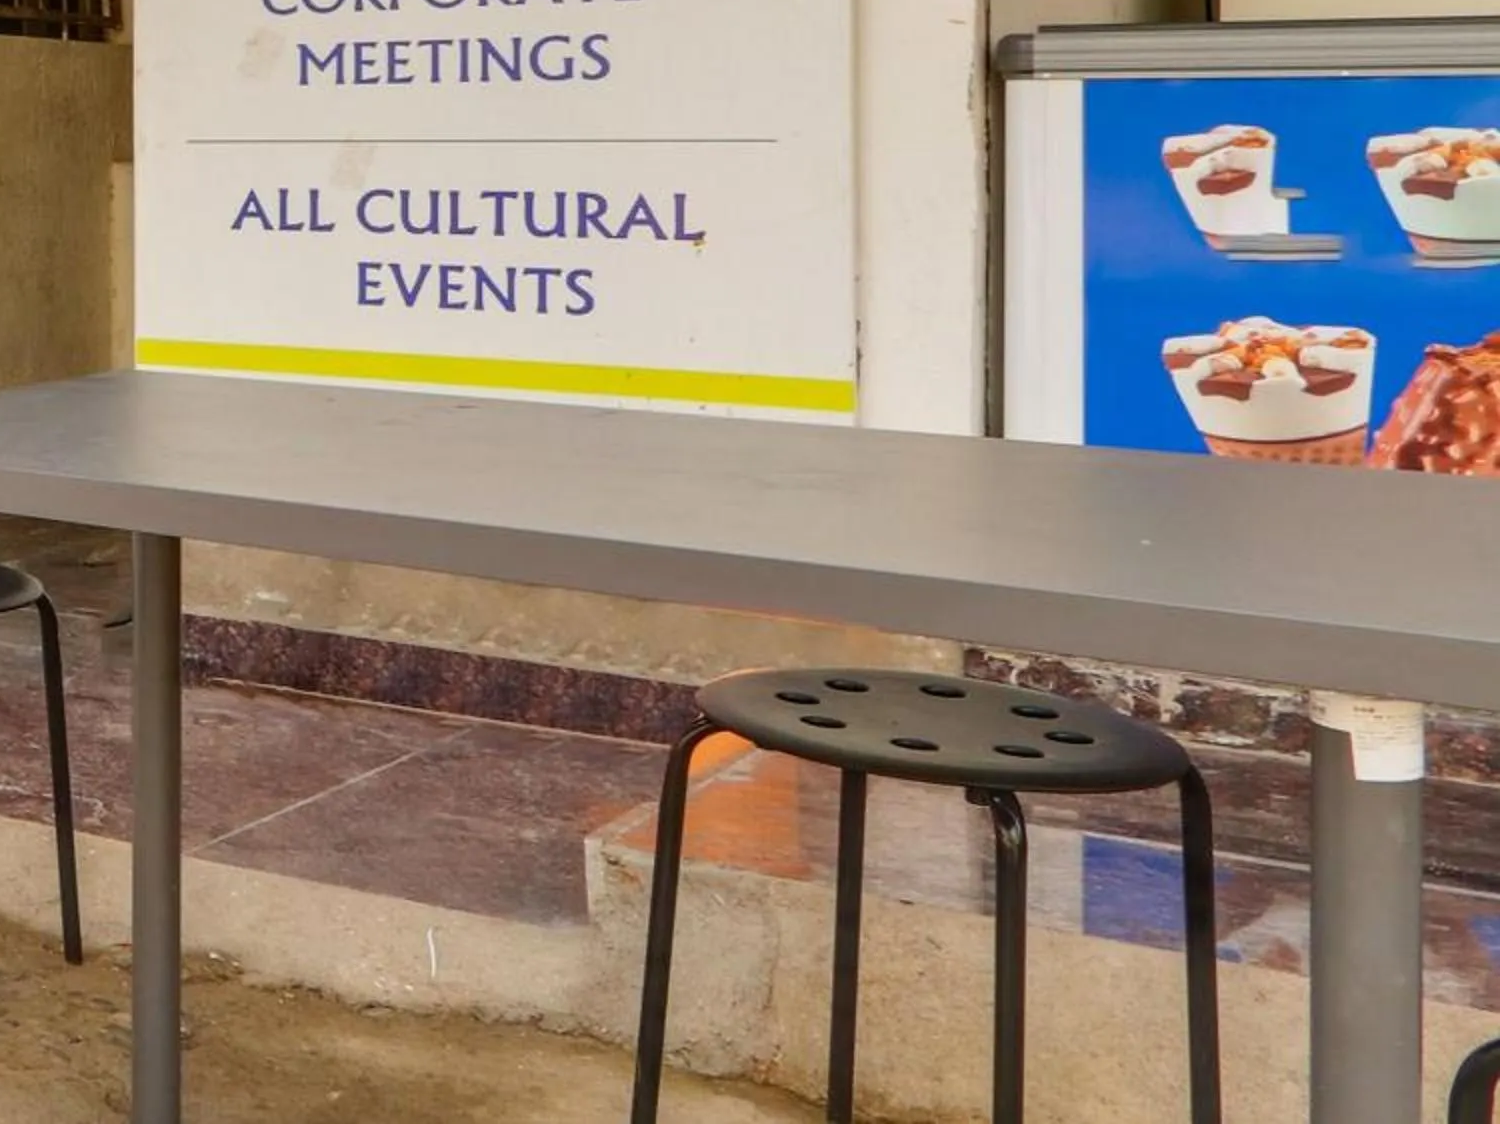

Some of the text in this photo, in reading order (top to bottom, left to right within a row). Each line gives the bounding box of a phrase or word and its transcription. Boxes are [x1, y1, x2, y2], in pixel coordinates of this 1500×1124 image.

[297, 34, 612, 86] MEETINGS
[231, 189, 706, 242] ALL CULTURAL
[356, 262, 596, 315] EVENTS
